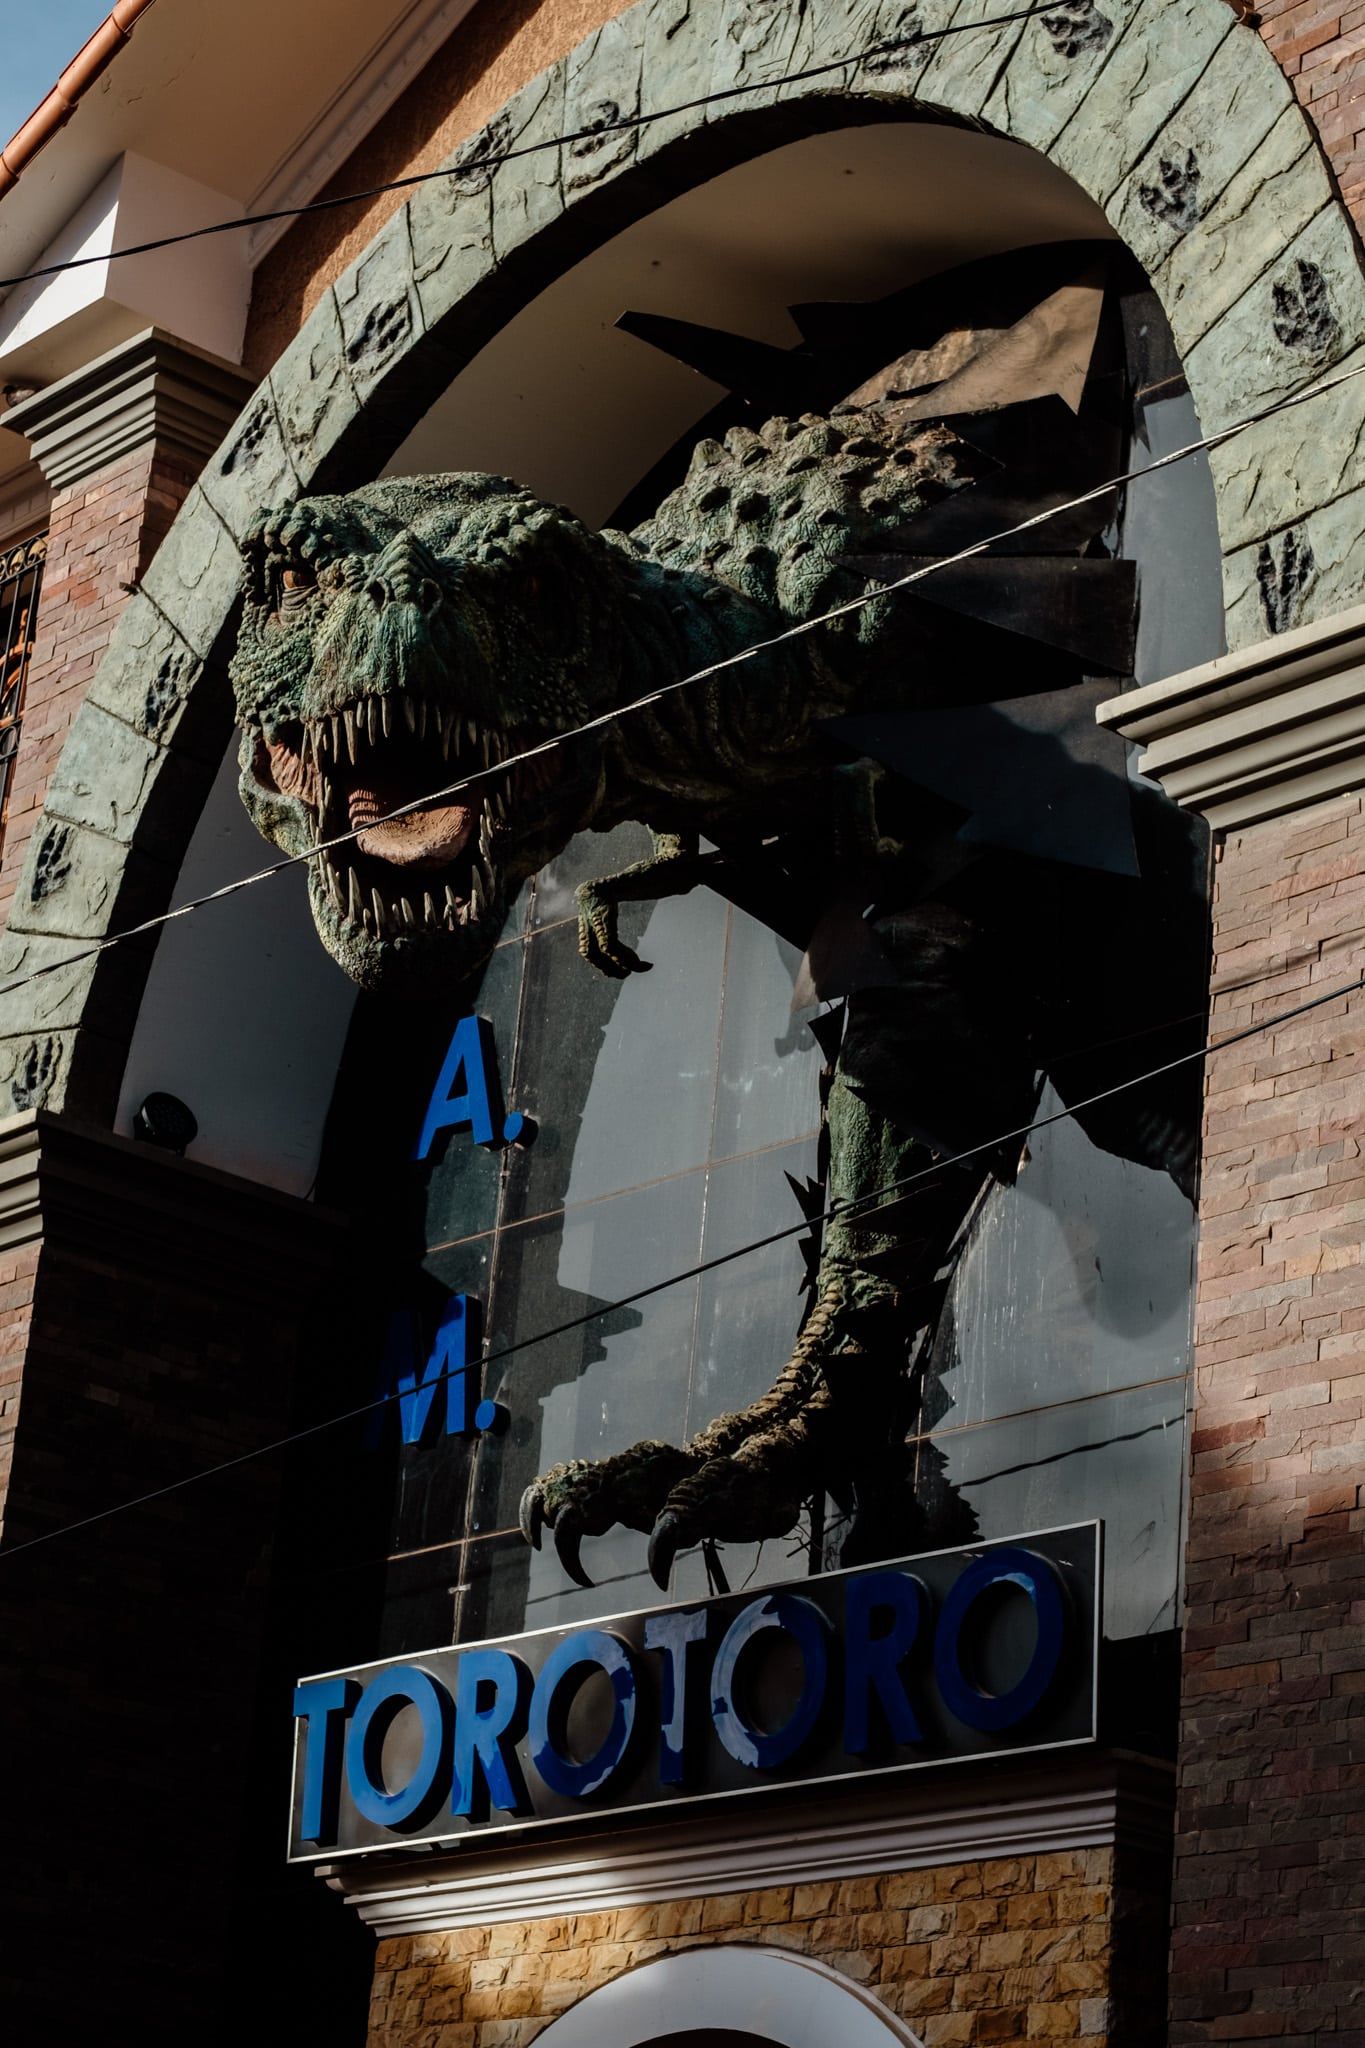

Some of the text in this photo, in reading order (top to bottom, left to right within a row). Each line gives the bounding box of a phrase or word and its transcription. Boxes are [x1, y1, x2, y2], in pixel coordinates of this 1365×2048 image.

[412, 1014, 525, 1161] A.
[362, 1294, 496, 1452] M.
[293, 1548, 1067, 1842] TOROTORO
